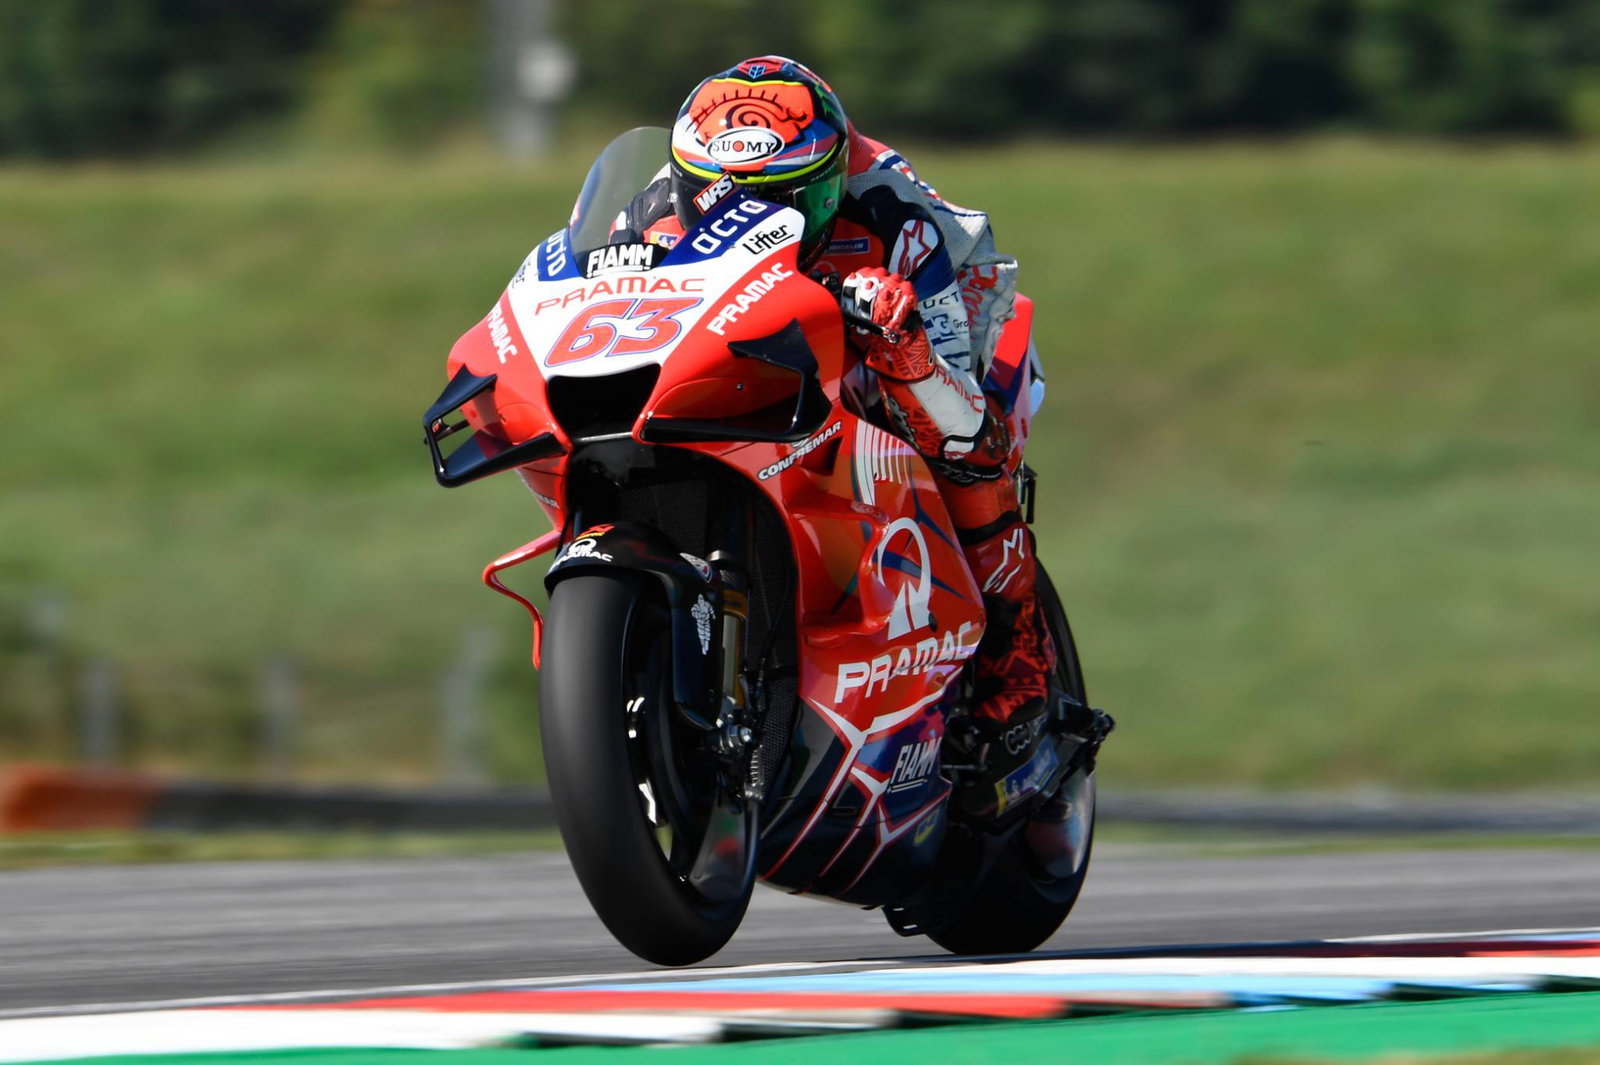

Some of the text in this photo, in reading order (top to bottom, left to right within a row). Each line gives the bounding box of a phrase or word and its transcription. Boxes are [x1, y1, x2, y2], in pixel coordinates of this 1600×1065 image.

[711, 139, 776, 155] SUOMY
[699, 174, 734, 212] WRS
[742, 224, 795, 255] Lifter
[586, 243, 654, 277] FIAMM
[535, 276, 705, 316] PRAMAC
[707, 262, 794, 336] PRAMAC
[544, 297, 704, 368] 63
[757, 420, 842, 480] CONFREMAR
[834, 621, 976, 704] PRAMAC
